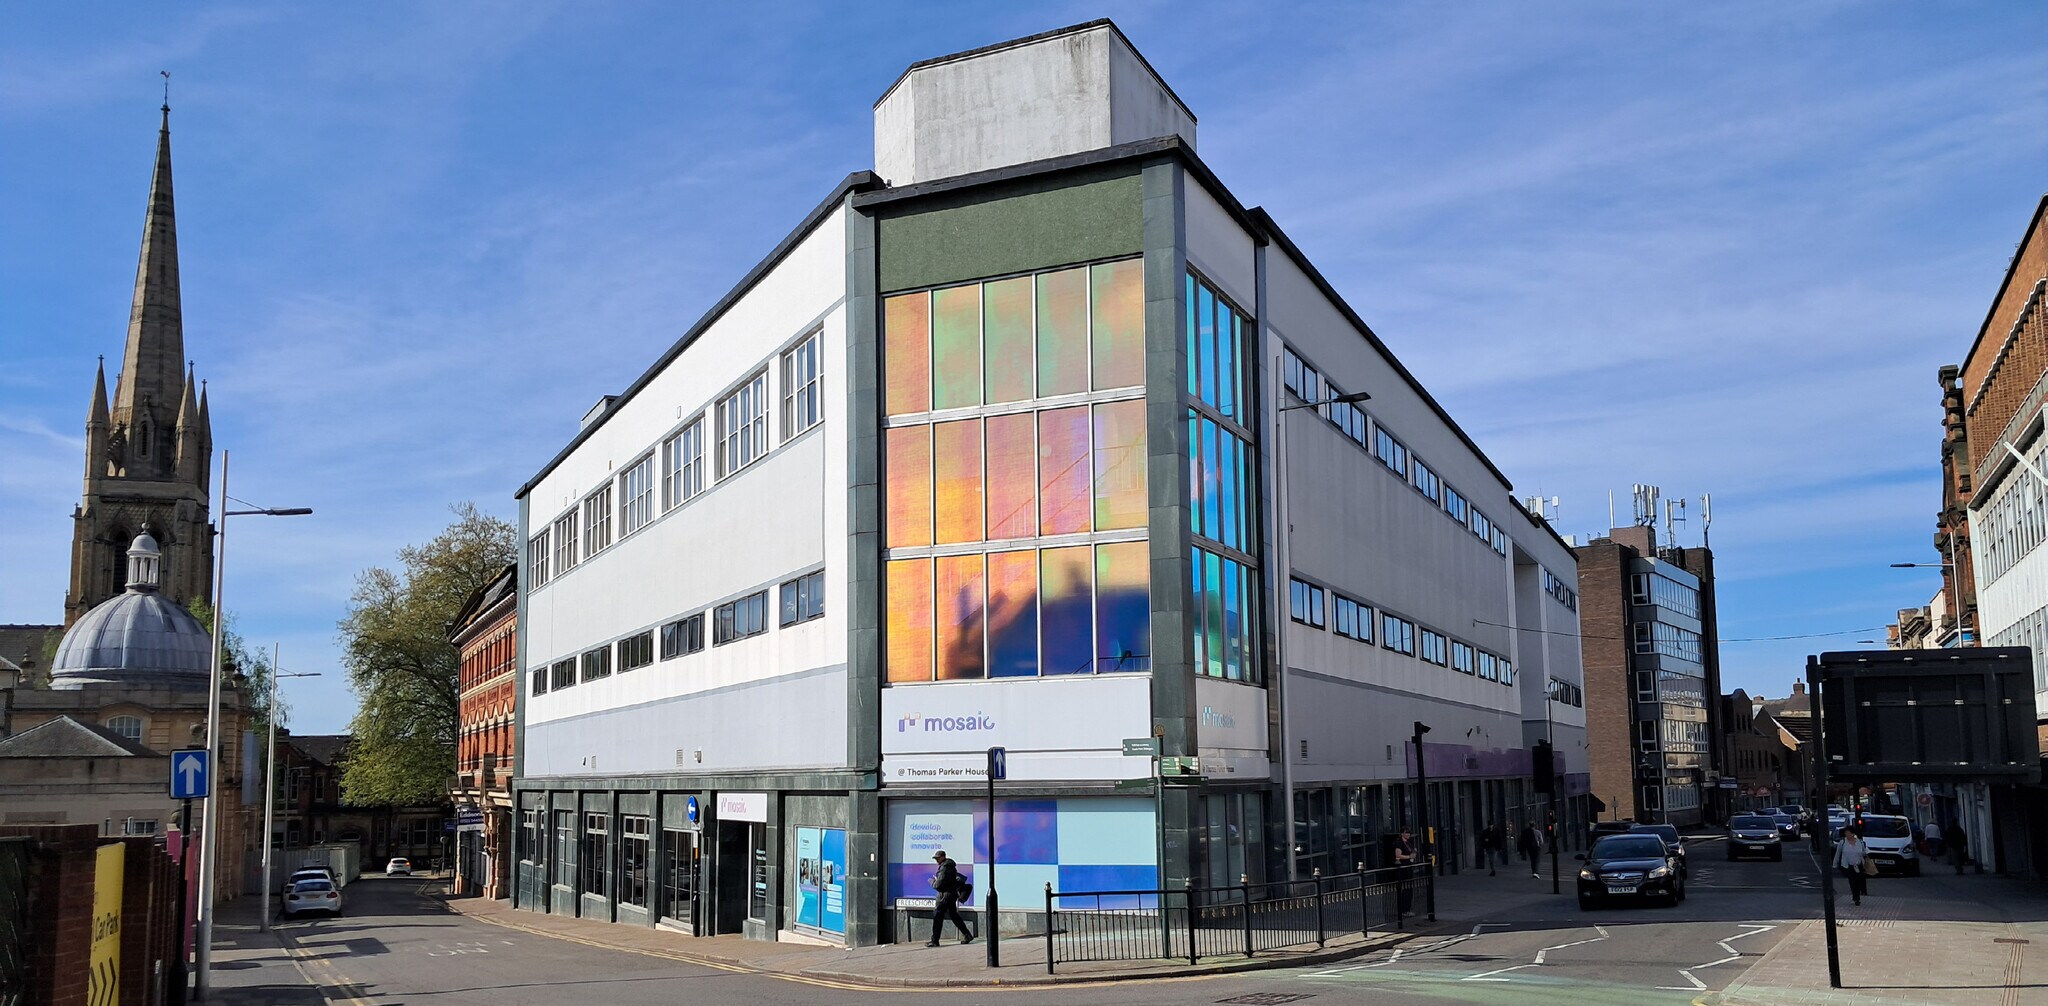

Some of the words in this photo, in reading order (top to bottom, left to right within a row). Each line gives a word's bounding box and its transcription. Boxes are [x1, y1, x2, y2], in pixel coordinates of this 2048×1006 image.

[924, 710, 996, 732] mosaic
[907, 768, 937, 776] Thomas
[938, 767, 963, 776] Parker
